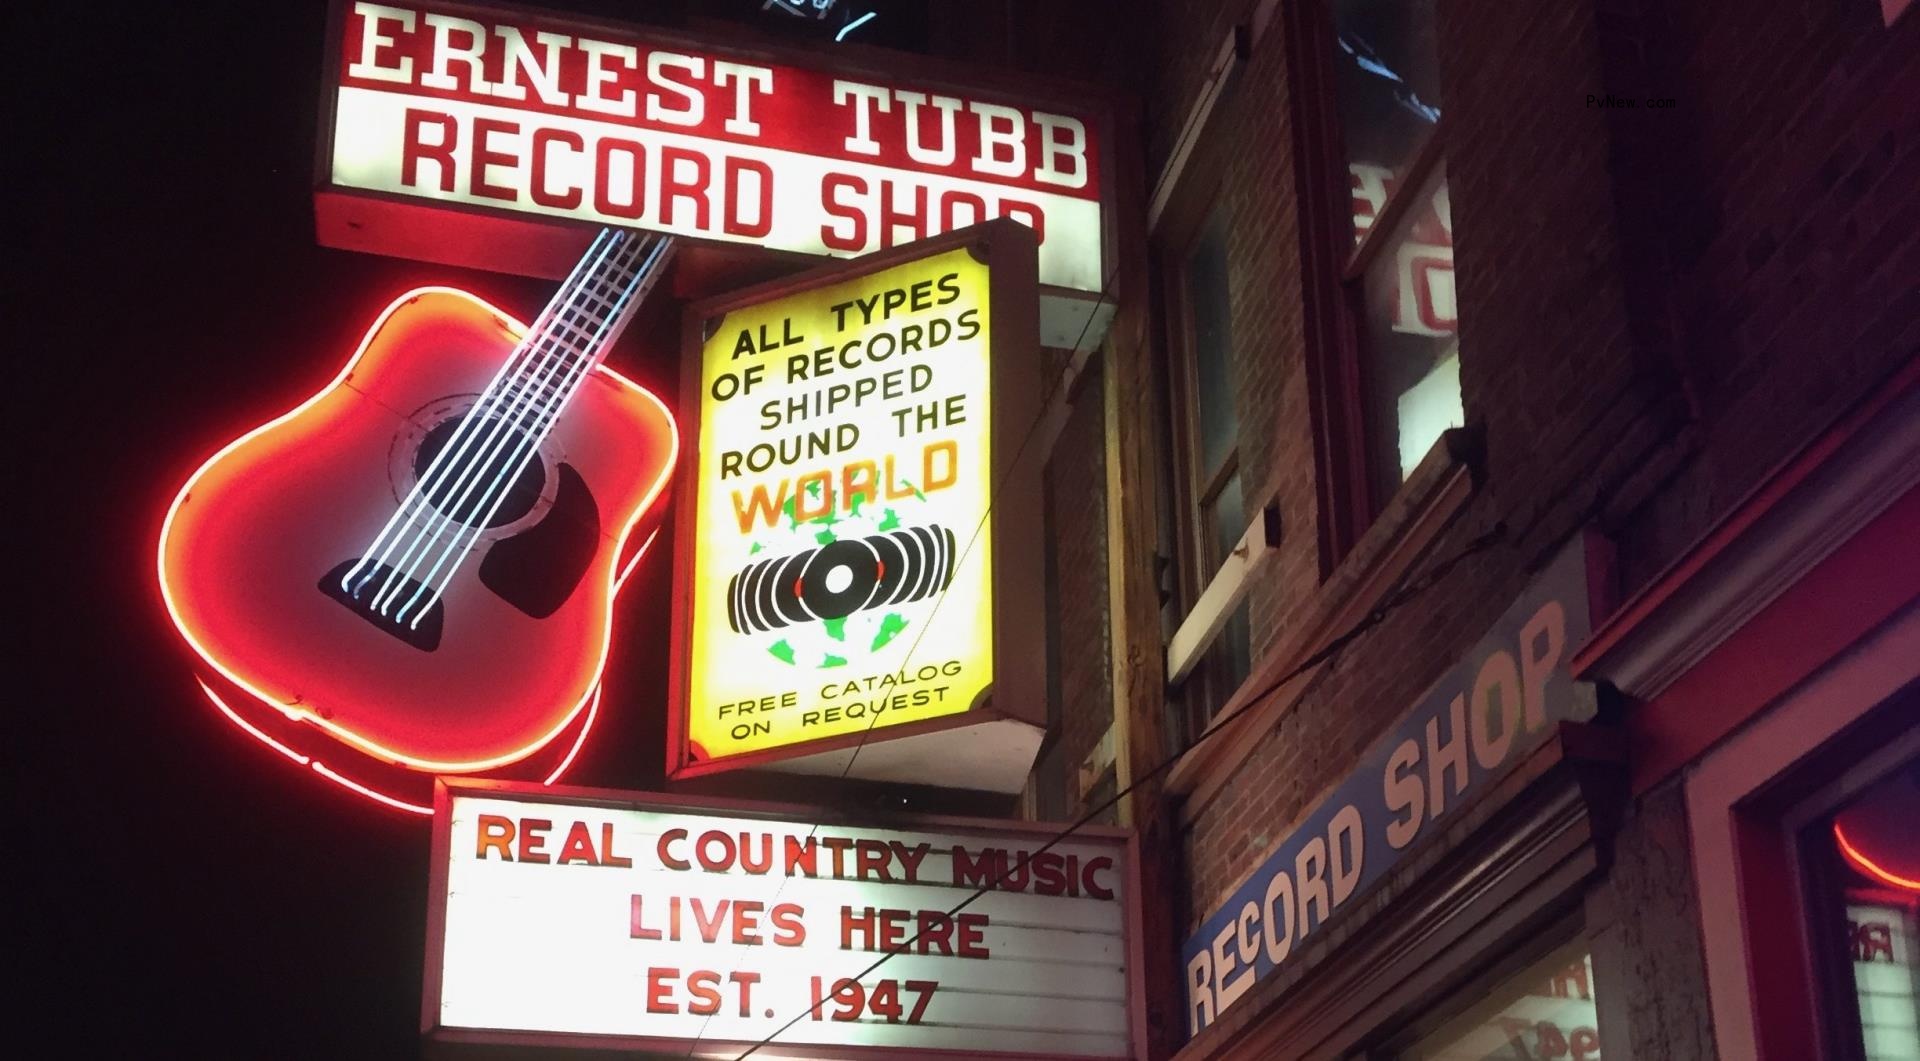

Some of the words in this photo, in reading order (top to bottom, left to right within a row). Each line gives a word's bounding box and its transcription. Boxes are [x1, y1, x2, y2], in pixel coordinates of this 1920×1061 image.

[349, 1, 774, 137] ERNEST
[833, 80, 1088, 189] TUBB
[401, 107, 774, 238] RECORD
[711, 364, 765, 402] OF
[787, 309, 981, 384] RECORDS
[731, 318, 804, 360] ALL
[831, 273, 961, 332] TYPES
[721, 423, 860, 480] ROUND
[891, 394, 967, 438] THE
[760, 364, 933, 430] SHIPPED
[731, 440, 958, 534] WORLD
[718, 692, 797, 720] FREE
[820, 661, 962, 699] CATALOG
[731, 721, 771, 740] ON
[802, 687, 950, 727] REQUEST
[476, 814, 633, 868] REAL
[656, 828, 931, 883] COUNTRY
[952, 845, 1115, 900] MUSIC
[1187, 804, 1364, 1038] RECORD
[1383, 600, 1565, 849] SHOP
[630, 894, 806, 947] LIVES
[840, 905, 990, 960] HERE
[646, 967, 775, 1020] EST.
[810, 976, 939, 1025] 1947
